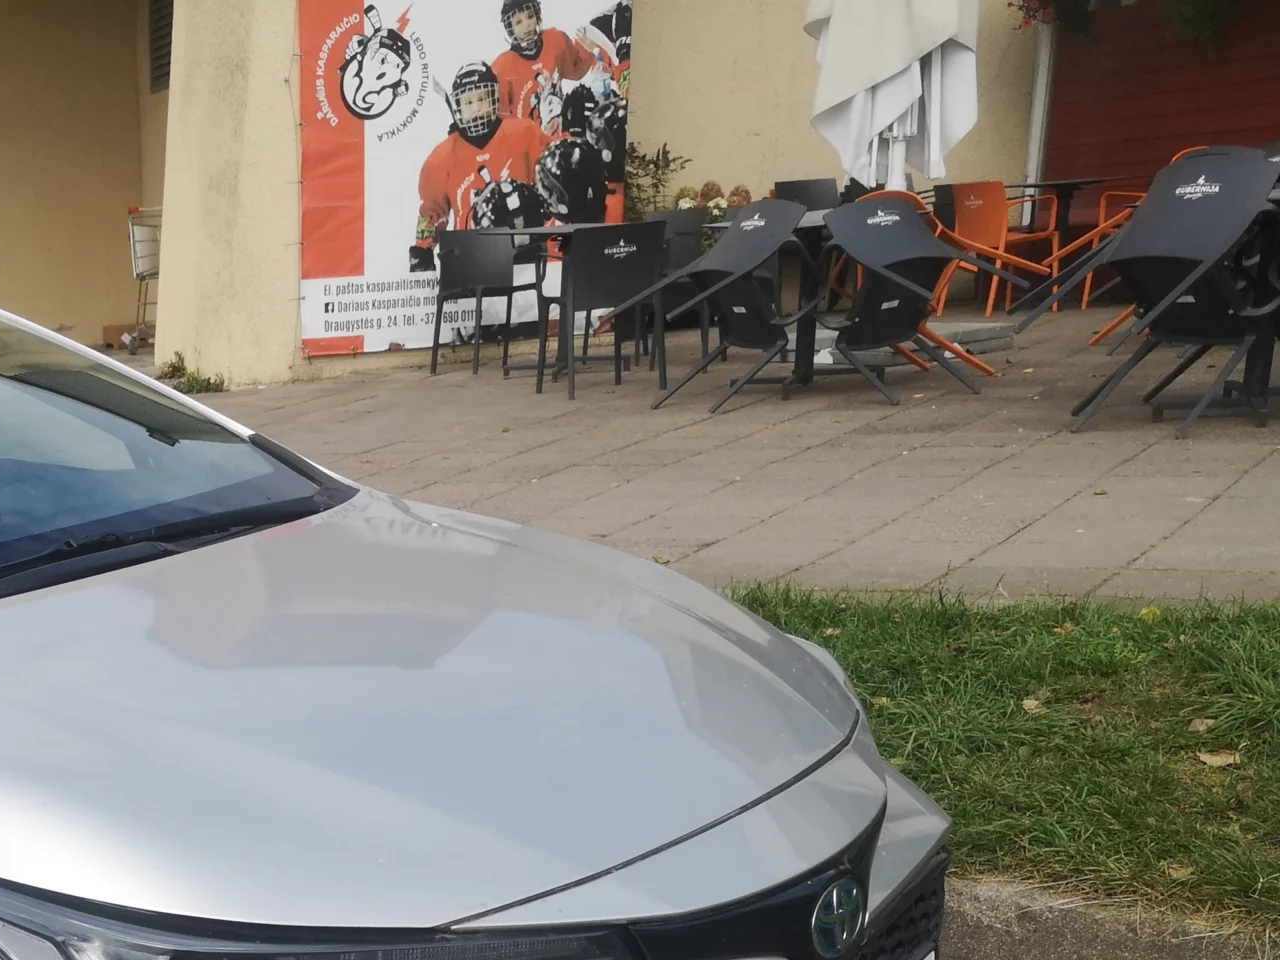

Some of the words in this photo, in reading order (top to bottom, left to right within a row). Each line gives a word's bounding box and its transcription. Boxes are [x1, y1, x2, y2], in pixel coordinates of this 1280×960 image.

[316, 13, 360, 75] KASPARAIČIO
[410, 31, 427, 60] LEDO
[416, 62, 429, 106] RITULIO
[316, 79, 339, 127] DARIUS
[376, 108, 419, 142] MOKYKLA
[1175, 185, 1220, 195] GUBERNIJA
[323, 284, 334, 296] El.
[335, 282, 364, 297] paštas
[337, 300, 370, 314] Dariaus
[371, 295, 421, 310] Kasparaičio
[324, 317, 375, 333] Draugystės
[376, 318, 384, 330] g.
[387, 314, 400, 328] 24.
[402, 313, 418, 326] Tel.
[419, 312, 435, 326] +37
[442, 310, 459, 324] 690
